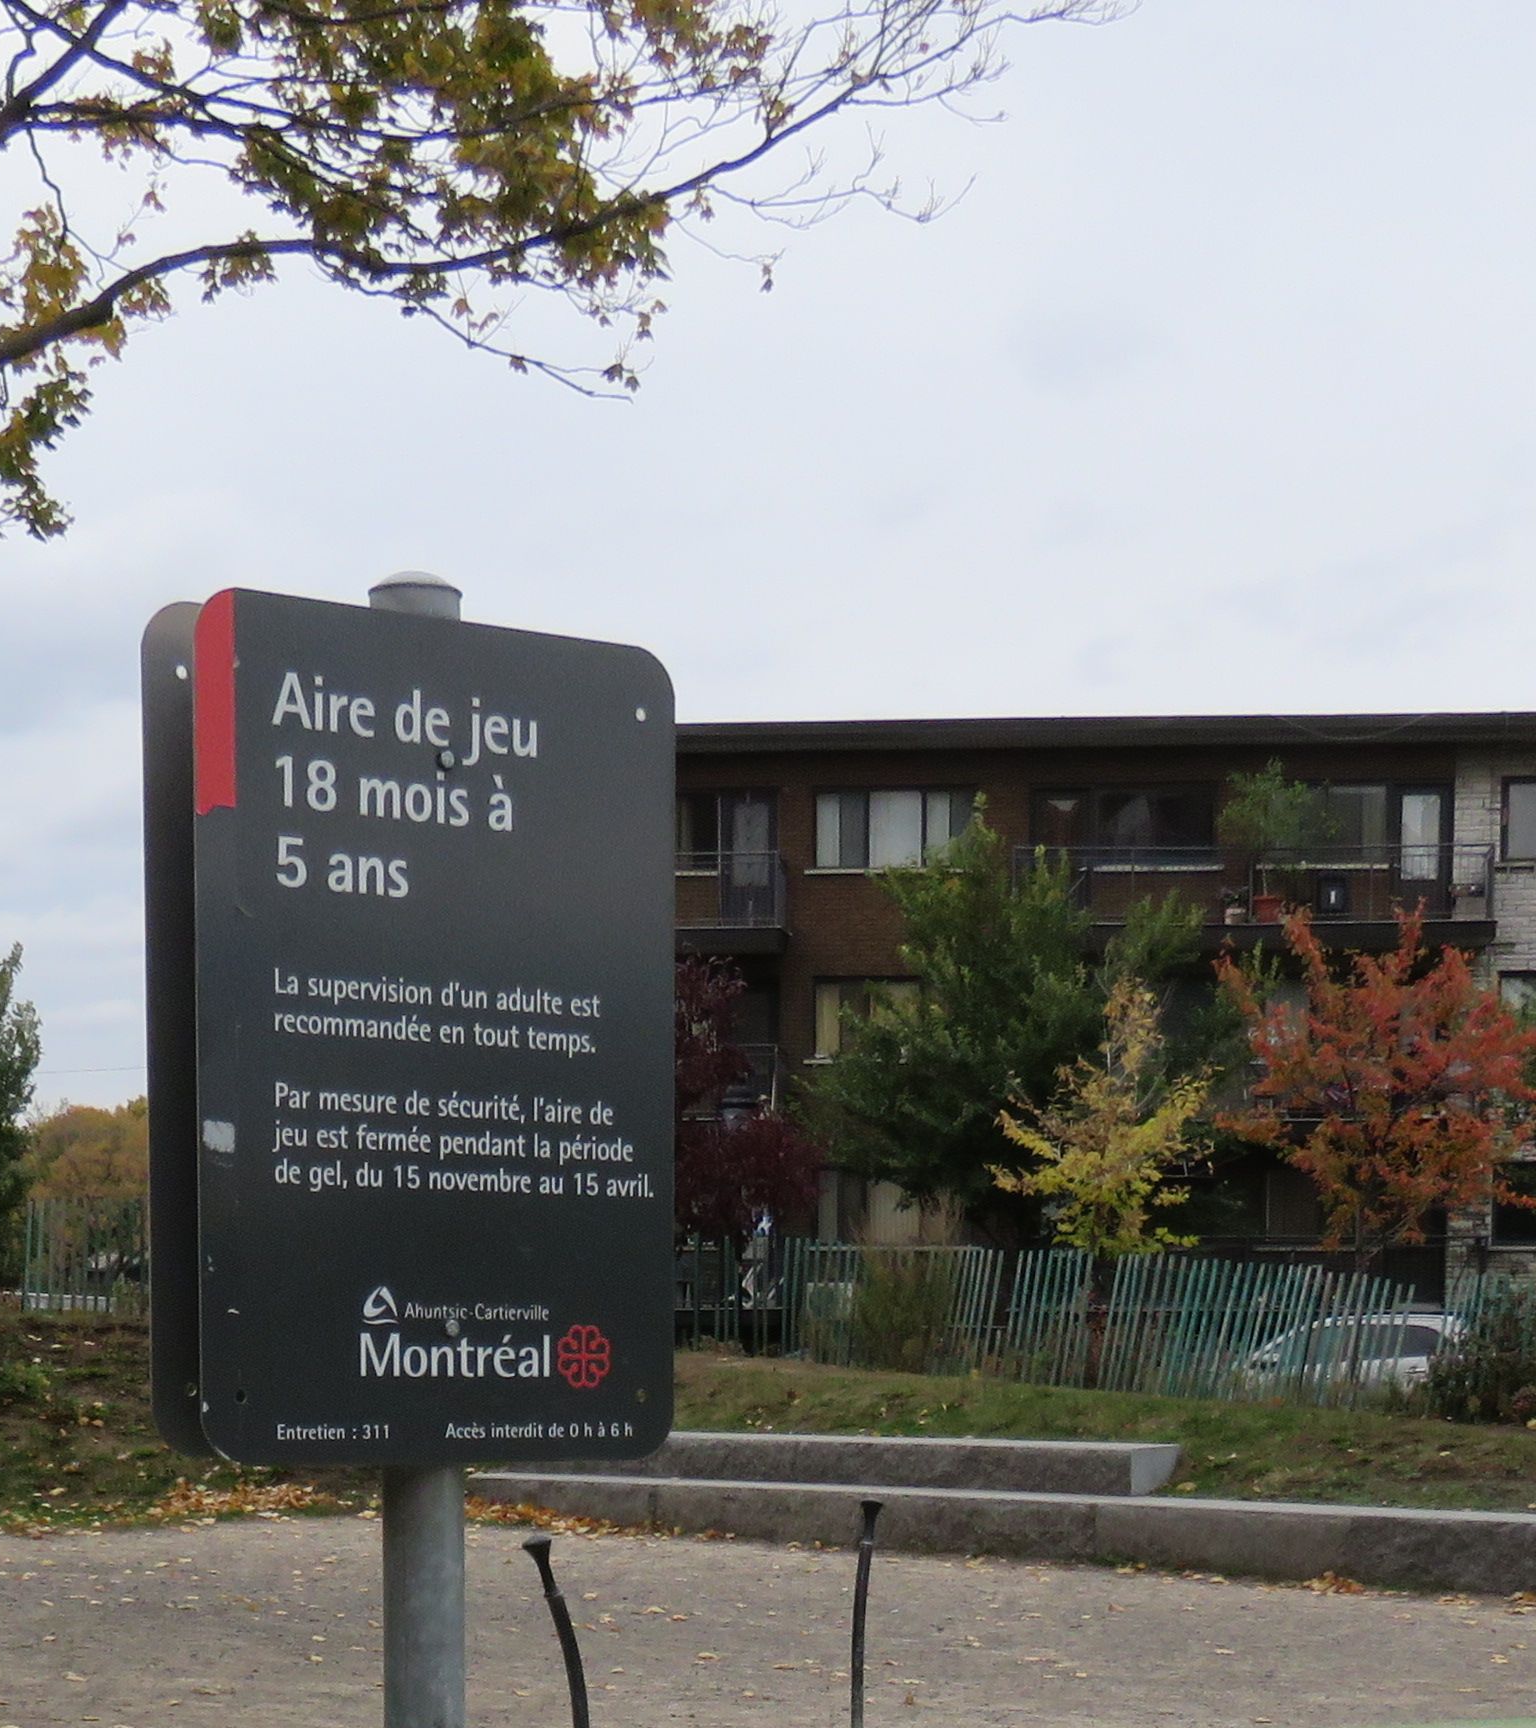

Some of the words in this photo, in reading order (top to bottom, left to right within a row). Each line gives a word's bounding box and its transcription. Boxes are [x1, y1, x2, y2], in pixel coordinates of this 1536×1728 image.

[271, 671, 376, 739] Aire
[394, 687, 451, 747] de
[461, 696, 538, 767] jeu
[274, 754, 338, 812] 18
[358, 770, 470, 828] mois
[488, 773, 513, 833] à
[275, 835, 308, 889] 5
[327, 852, 410, 899] ans
[274, 967, 299, 996] La
[307, 975, 433, 1006] supervision
[440, 980, 488, 1011] d'un
[495, 985, 563, 1016] adulte
[570, 994, 601, 1019] est
[273, 1012, 432, 1043] recommandée
[439, 1024, 465, 1045] en
[472, 1022, 520, 1049] tout
[526, 1025, 597, 1059] temps.
[274, 1080, 312, 1110] Par
[318, 1091, 398, 1115] mesure
[404, 1089, 431, 1117] de
[437, 1093, 526, 1125] sécurité,
[533, 1096, 583, 1125] l'aire
[589, 1099, 614, 1126] de
[271, 1119, 308, 1153] jeu
[316, 1125, 349, 1150] est
[355, 1123, 432, 1154] fermée
[439, 1130, 527, 1161] pendant
[533, 1132, 551, 1159] la
[559, 1133, 634, 1166] période
[274, 1157, 302, 1185] de
[308, 1159, 348, 1193] gel,
[355, 1161, 383, 1188] du
[393, 1164, 421, 1190] 15
[428, 1167, 532, 1194] novembre
[538, 1175, 564, 1195] au
[573, 1171, 600, 1197] 15
[605, 1172, 655, 1199] avril.
[403, 1301, 550, 1322] Ahuntsic-Cartierville
[359, 1331, 551, 1379] Montréal
[276, 1422, 346, 1441] Entretien
[361, 1423, 390, 1441] 311
[444, 1421, 487, 1440] Accès
[490, 1421, 544, 1440] interdit
[548, 1422, 565, 1439] de
[569, 1422, 580, 1439] 0
[583, 1421, 593, 1438] h
[597, 1420, 606, 1438] à
[610, 1421, 620, 1438] 6
[624, 1421, 633, 1438] h
